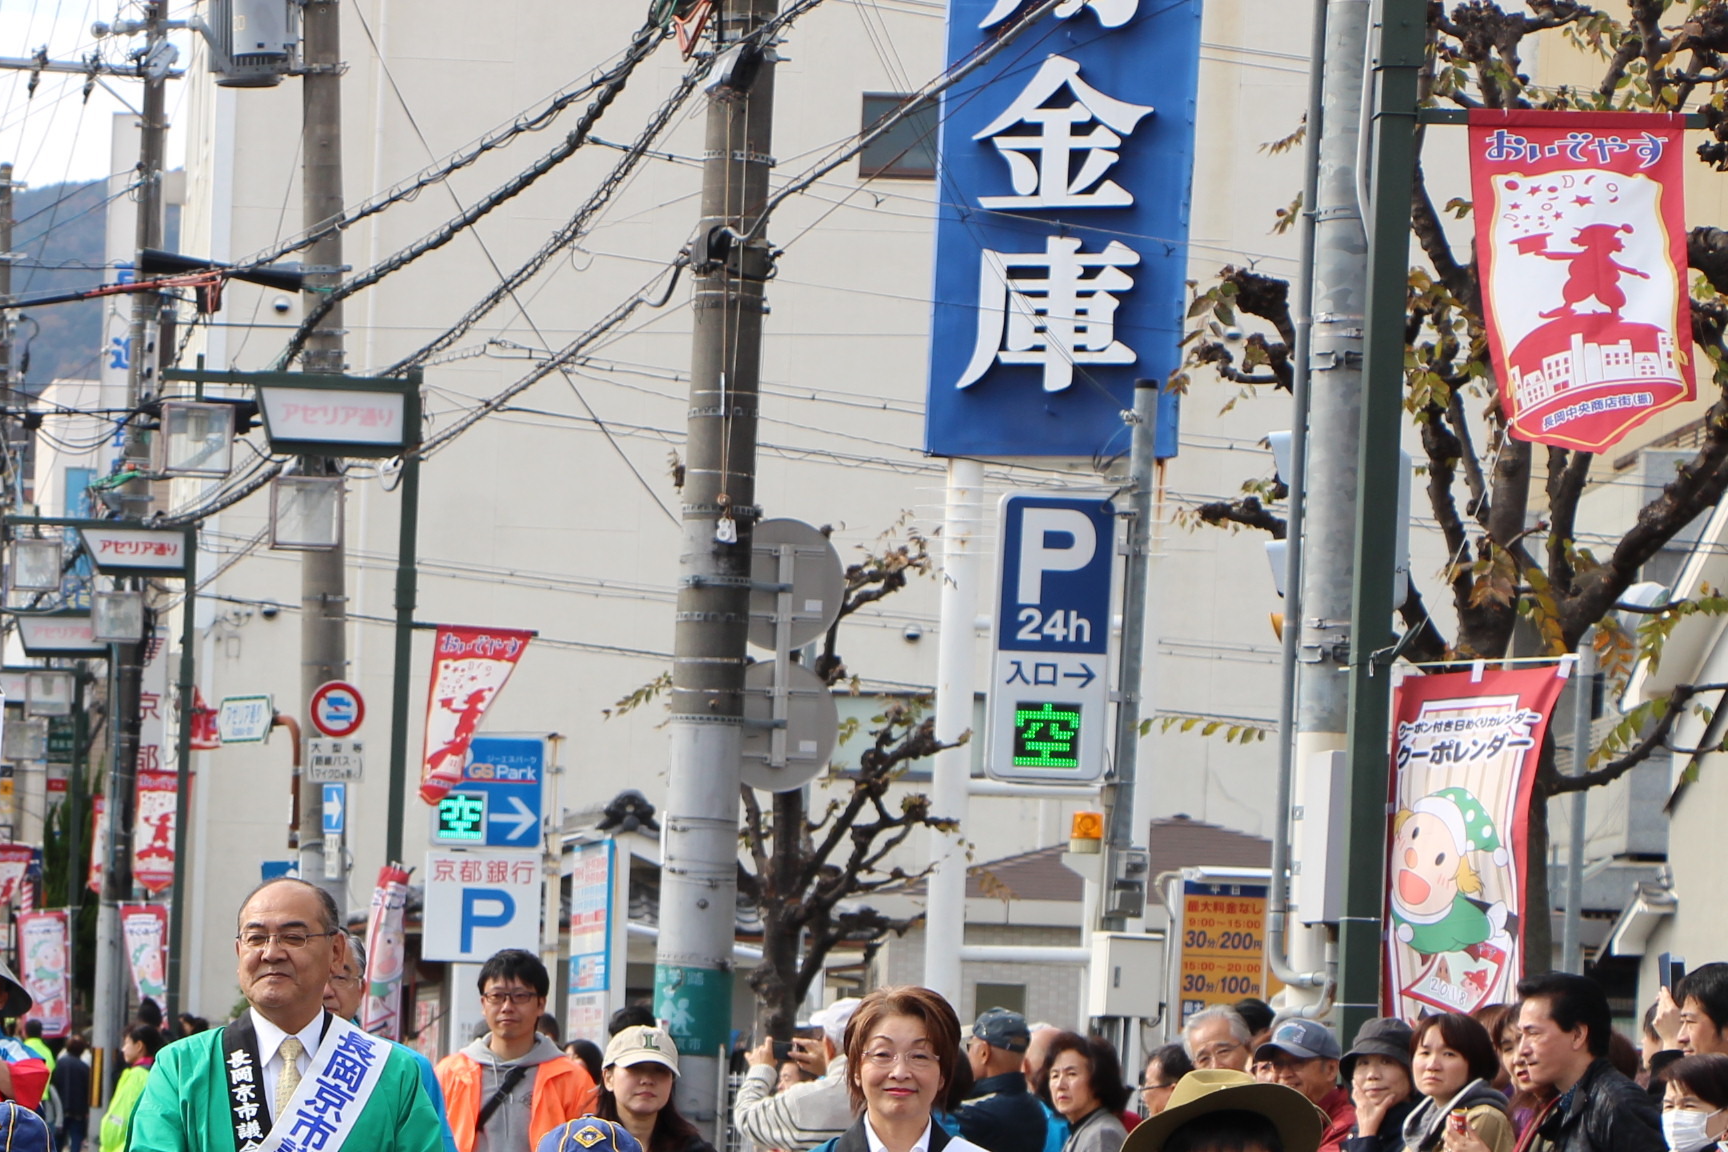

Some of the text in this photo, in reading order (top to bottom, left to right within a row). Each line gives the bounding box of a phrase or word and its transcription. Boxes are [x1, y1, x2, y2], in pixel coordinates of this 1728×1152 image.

[1486, 130, 1668, 168] おいでやす
[1542, 392, 1654, 431] 長岡中央商店街(振)
[1018, 507, 1097, 604] P
[1016, 608, 1091, 643] 24h
[1006, 661, 1058, 687] 入口
[1013, 703, 1079, 768] 空
[1399, 711, 1540, 741] クーポン付き日めくりカレンダー
[1397, 733, 1531, 769] クーポレンダー
[469, 763, 536, 780] GS Park
[437, 794, 482, 840] 空
[433, 860, 535, 885] 京都銀行
[460, 887, 516, 953] P
[1187, 901, 1262, 914] 最大料金なし
[1184, 930, 1262, 950] 30分/200円
[1183, 975, 1260, 994] 30分/100円
[1429, 978, 1468, 1005] 2018
[644, 1034, 660, 1050] L
